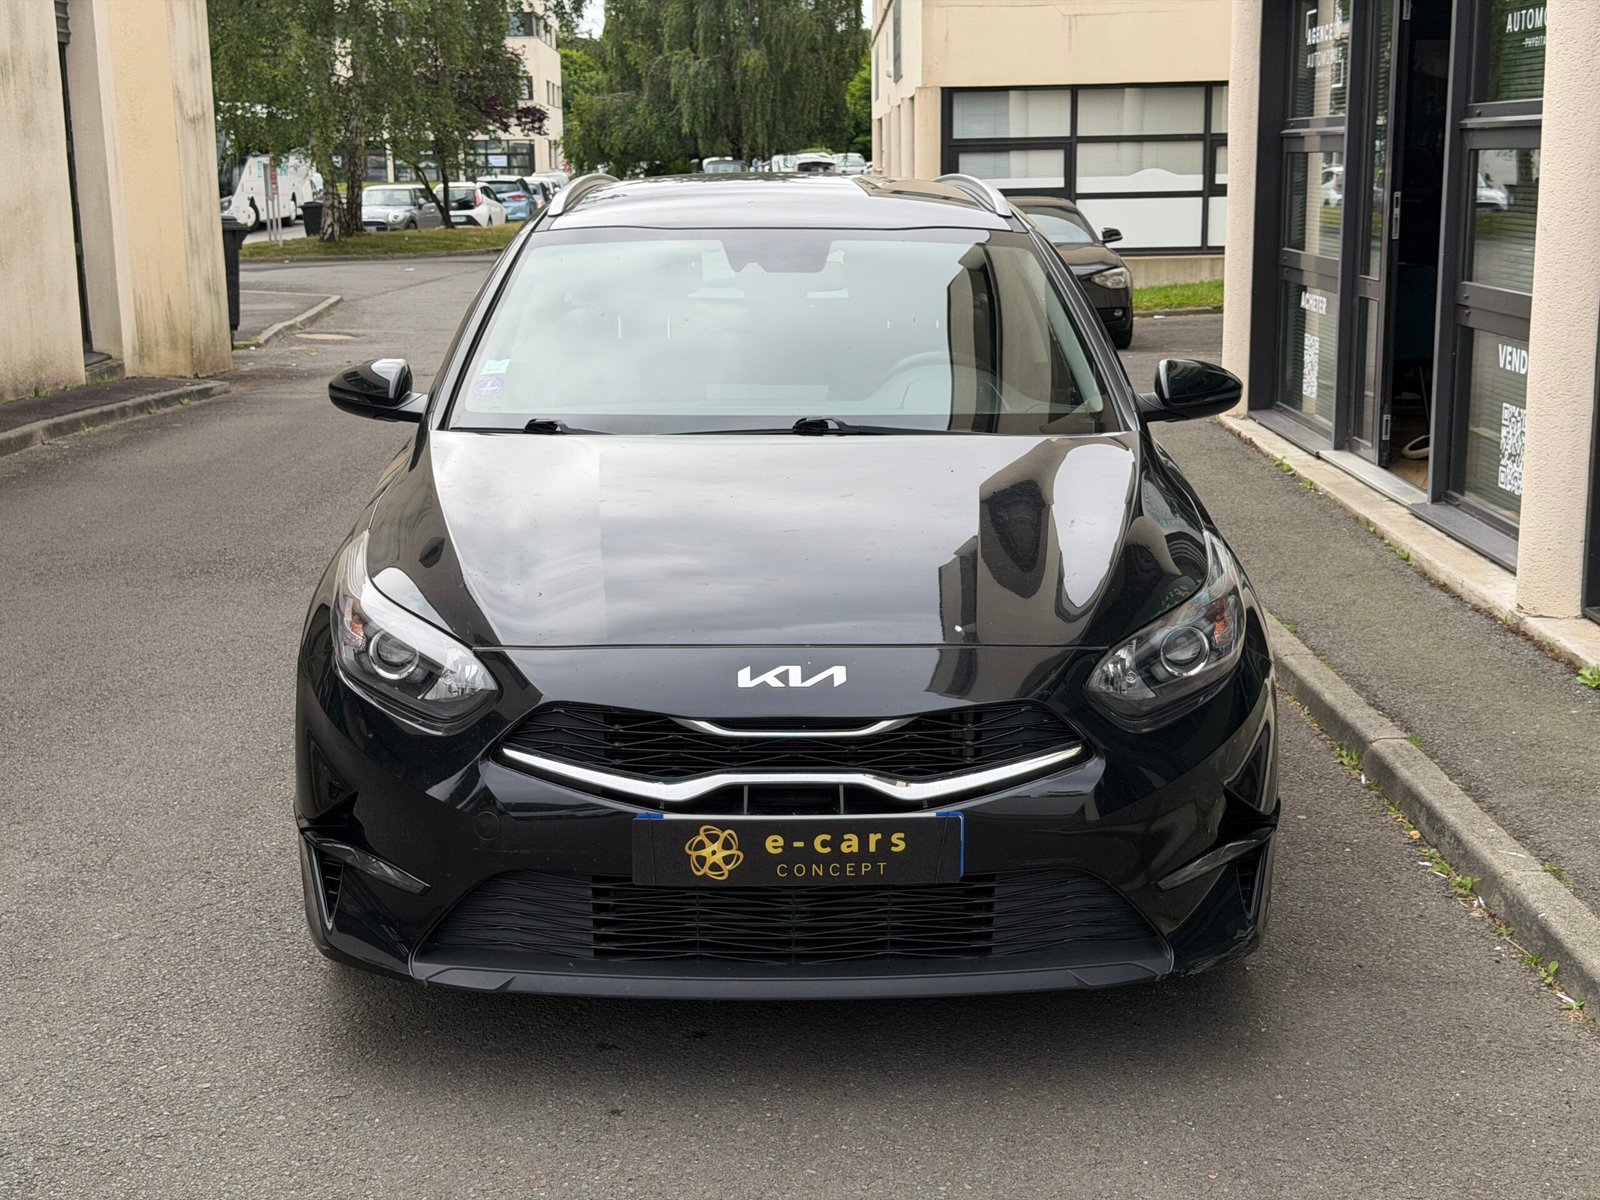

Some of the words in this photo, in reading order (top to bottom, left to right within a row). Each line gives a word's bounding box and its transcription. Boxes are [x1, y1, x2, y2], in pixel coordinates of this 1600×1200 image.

[1306, 23, 1333, 45] AGENCE
[1300, 291, 1327, 315] ACHETER
[737, 665, 847, 688] KIA
[765, 832, 906, 854] e-cars
[776, 862, 887, 877] CONCEPT
